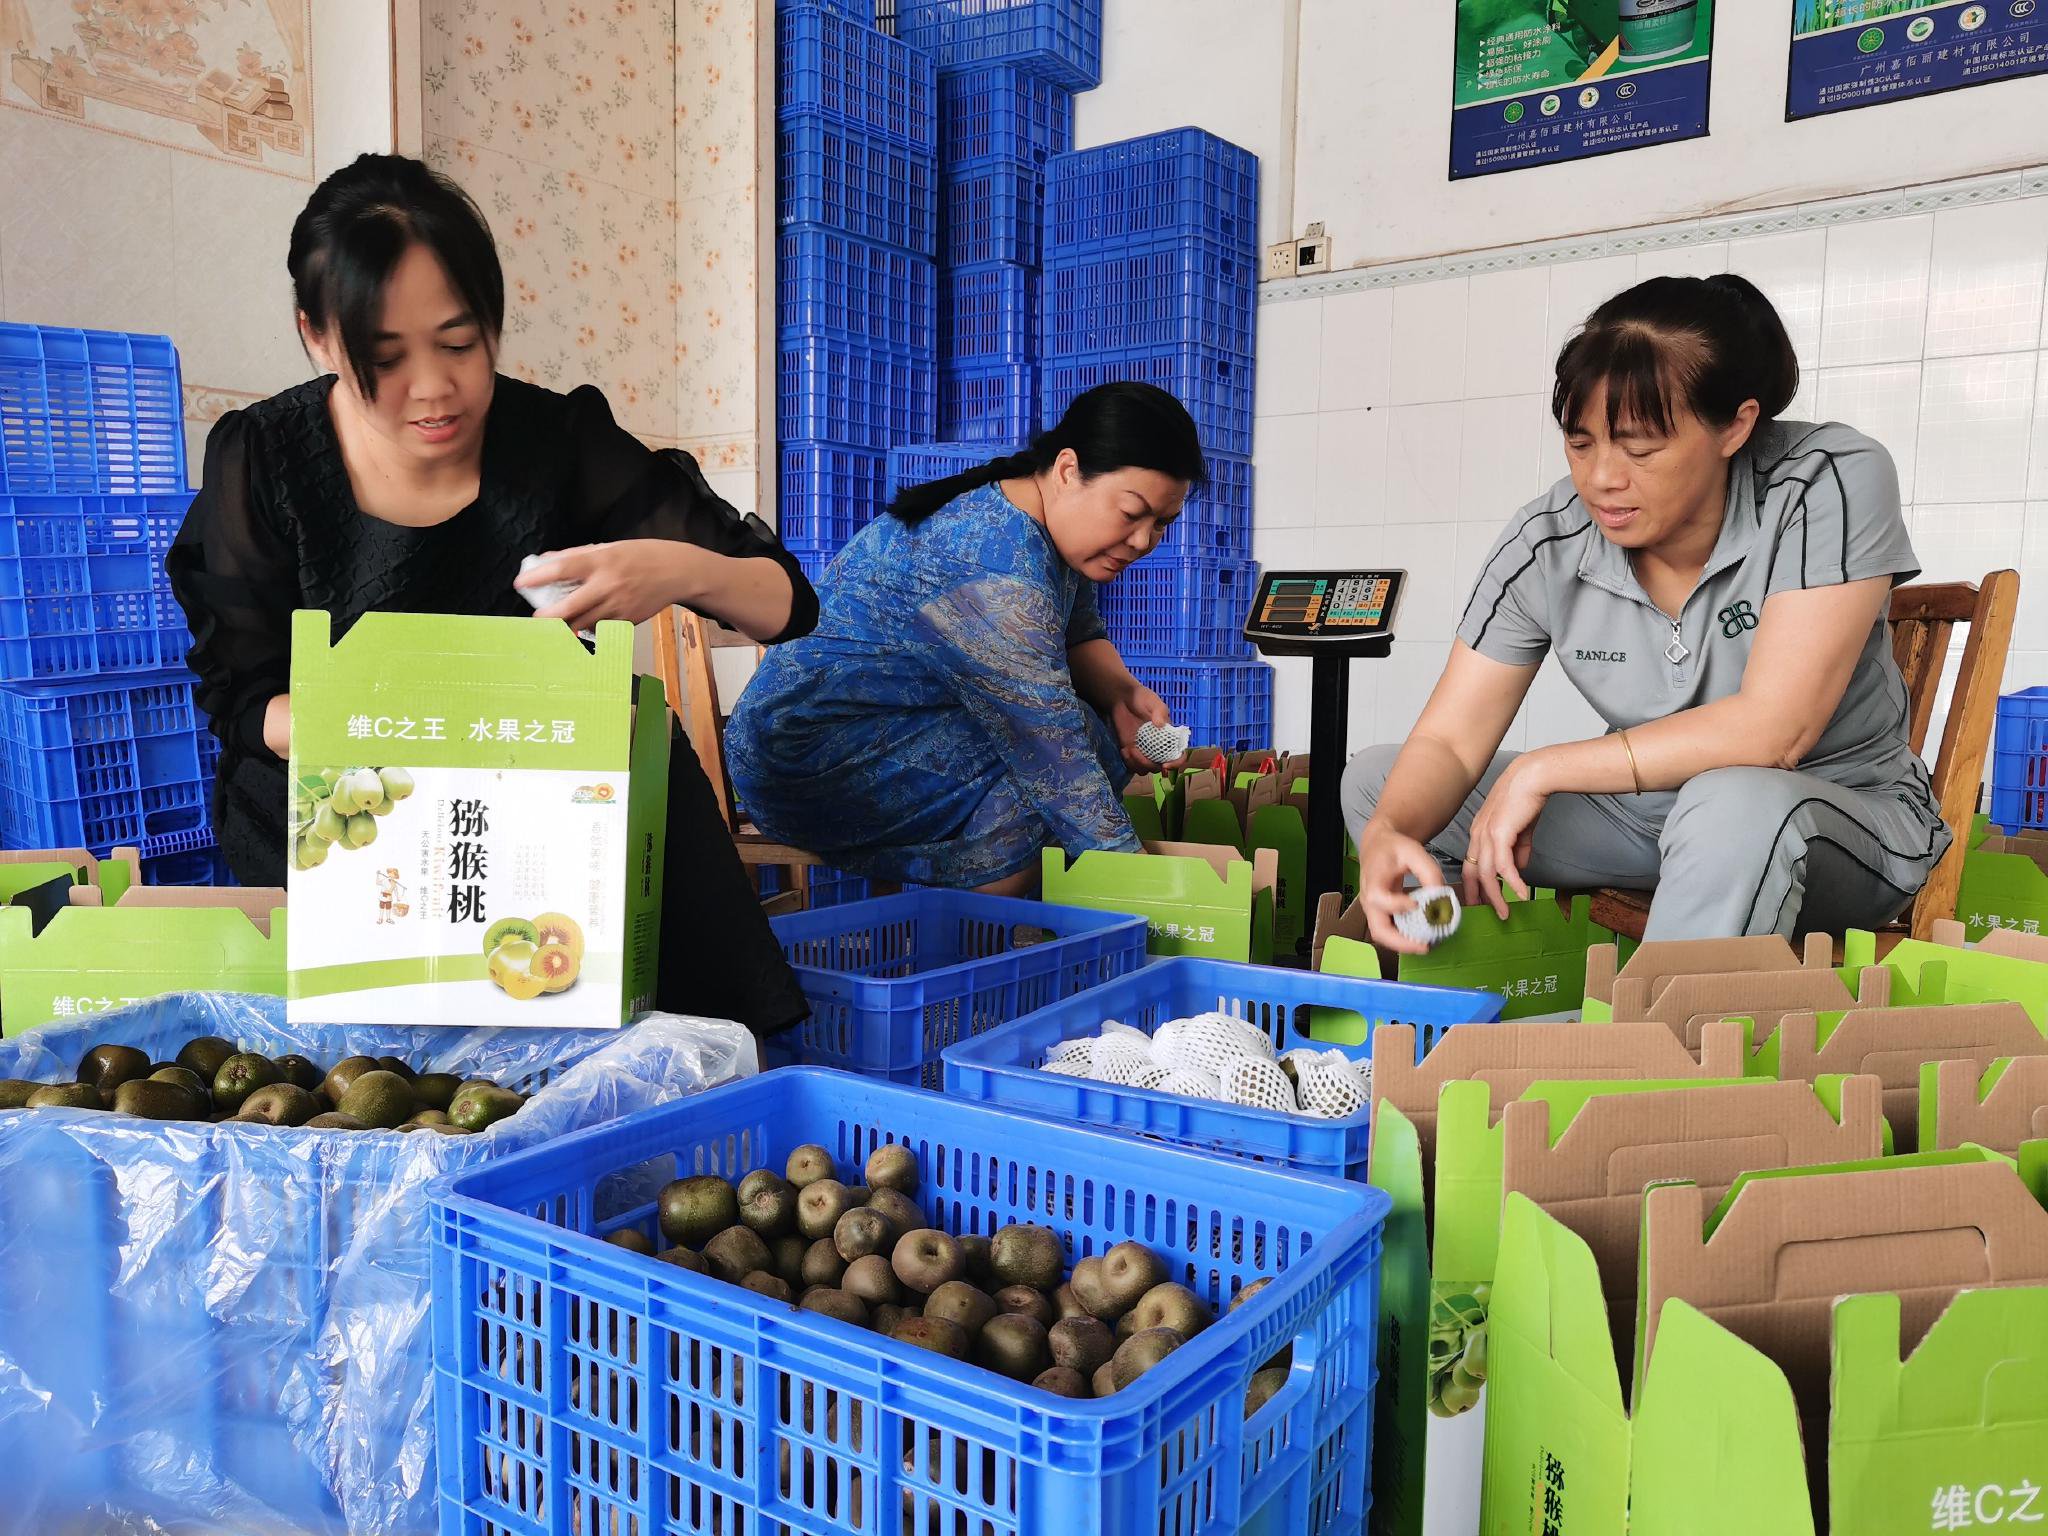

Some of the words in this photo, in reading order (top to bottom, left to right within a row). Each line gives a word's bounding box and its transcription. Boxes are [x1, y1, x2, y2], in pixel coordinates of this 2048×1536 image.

[1962, 53, 2048, 76] 通过ISO14001环境管
[347, 713, 447, 740] 维C之王
[468, 716, 576, 744] 水果之冠
[447, 798, 490, 923] 猕猴桃
[1147, 921, 1216, 943] 水果之冠
[1970, 912, 2040, 936] 水果之冠
[1500, 974, 1558, 999] 水果之冠
[1931, 1478, 2045, 1532] 维C之
